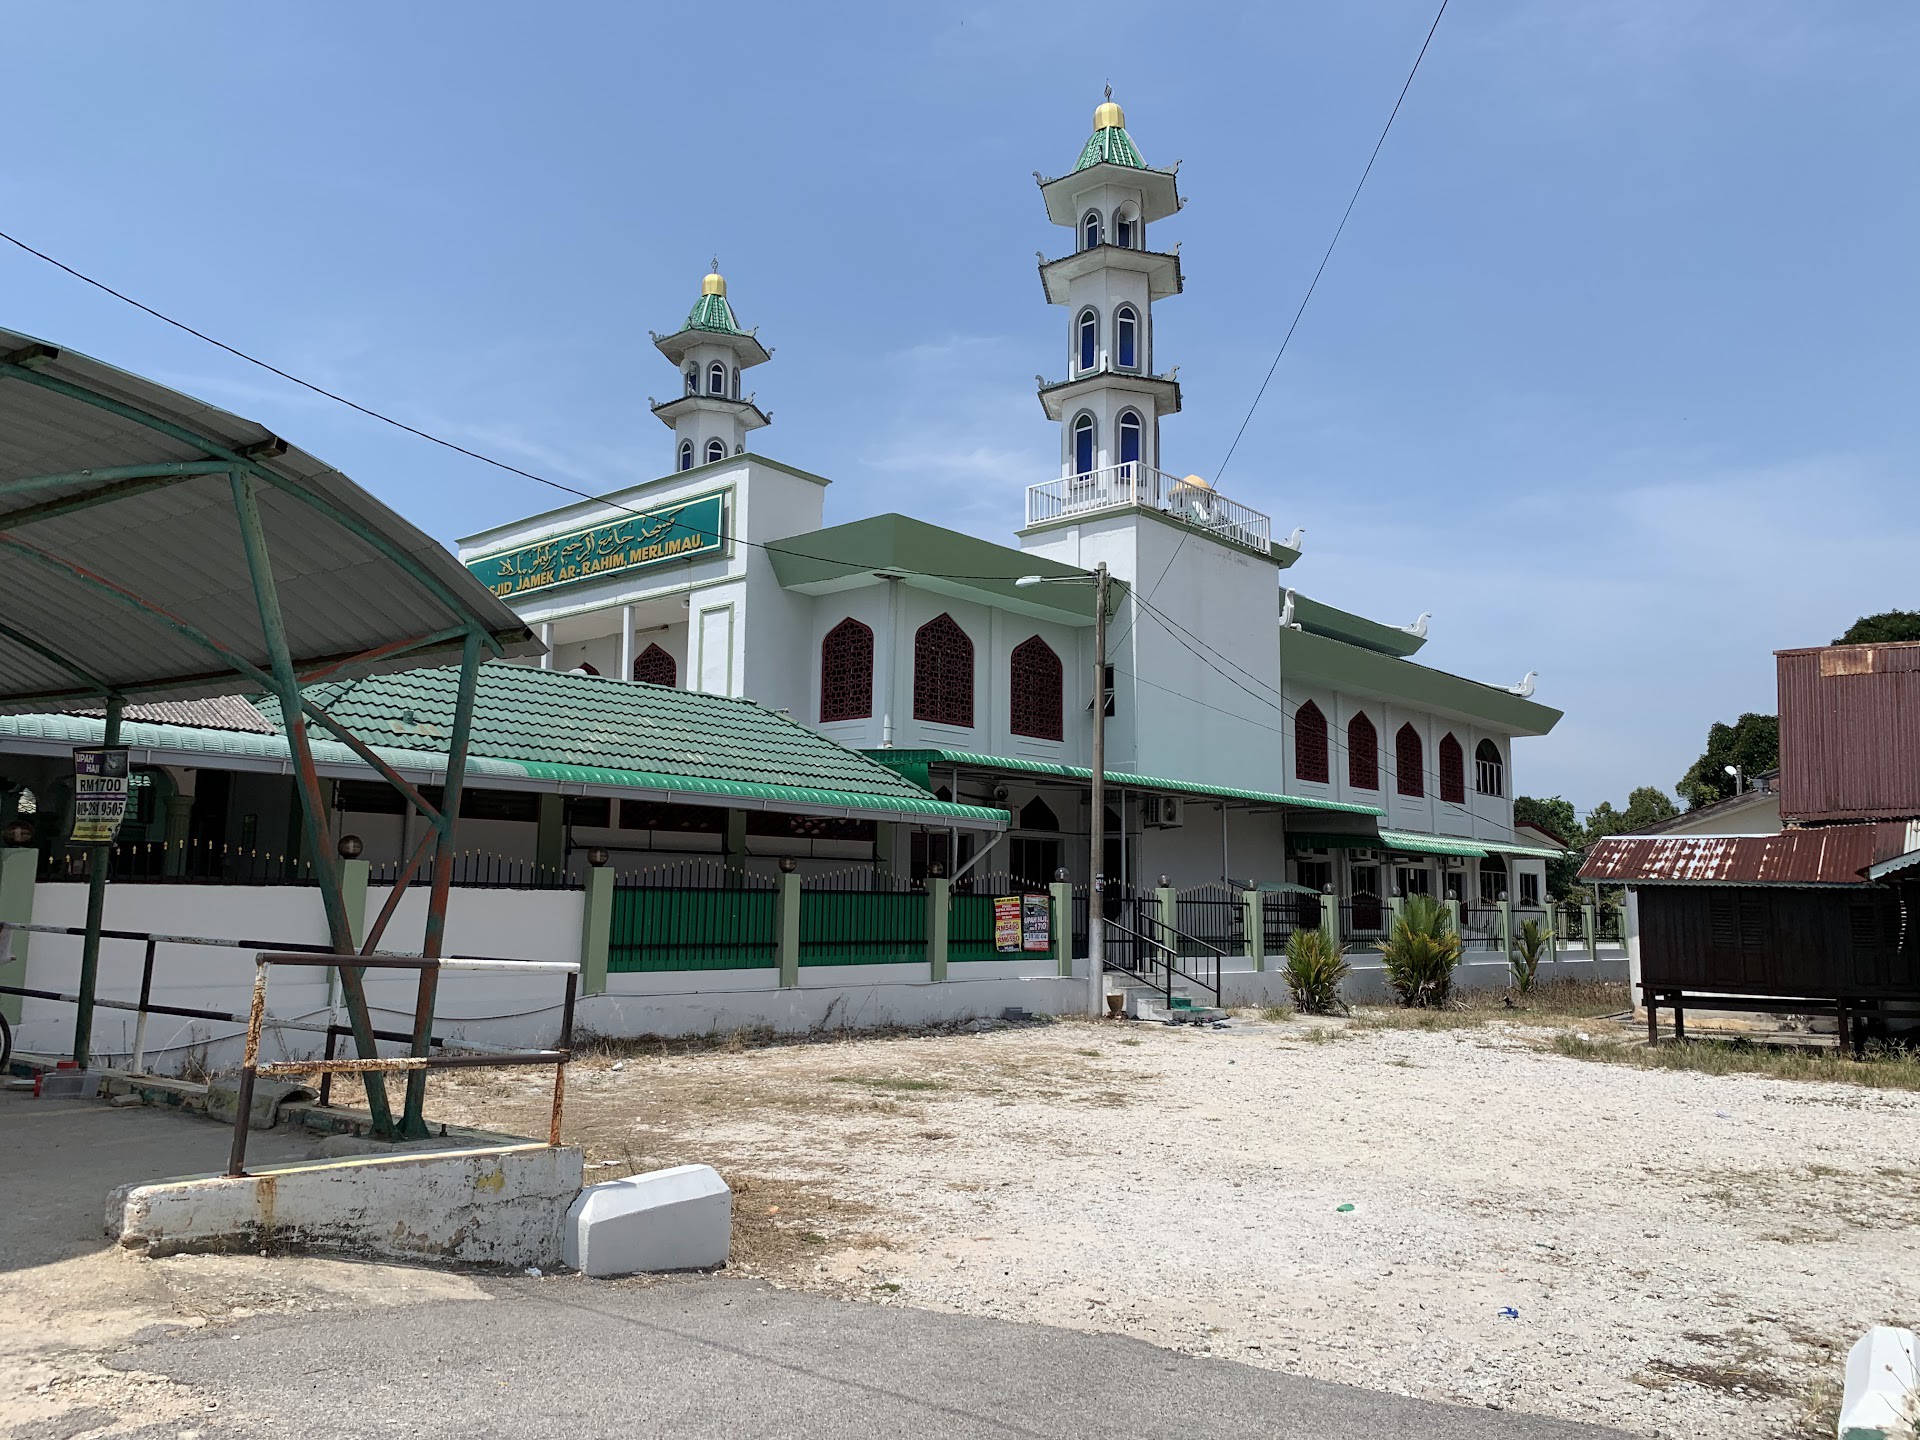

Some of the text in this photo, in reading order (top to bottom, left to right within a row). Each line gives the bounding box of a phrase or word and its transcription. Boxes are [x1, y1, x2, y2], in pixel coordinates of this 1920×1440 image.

[488, 581, 512, 597] SJID
[516, 570, 555, 591] JAMEK
[76, 754, 94, 763] UPAH
[80, 779, 121, 792] RM1700
[101, 802, 123, 816] 9505
